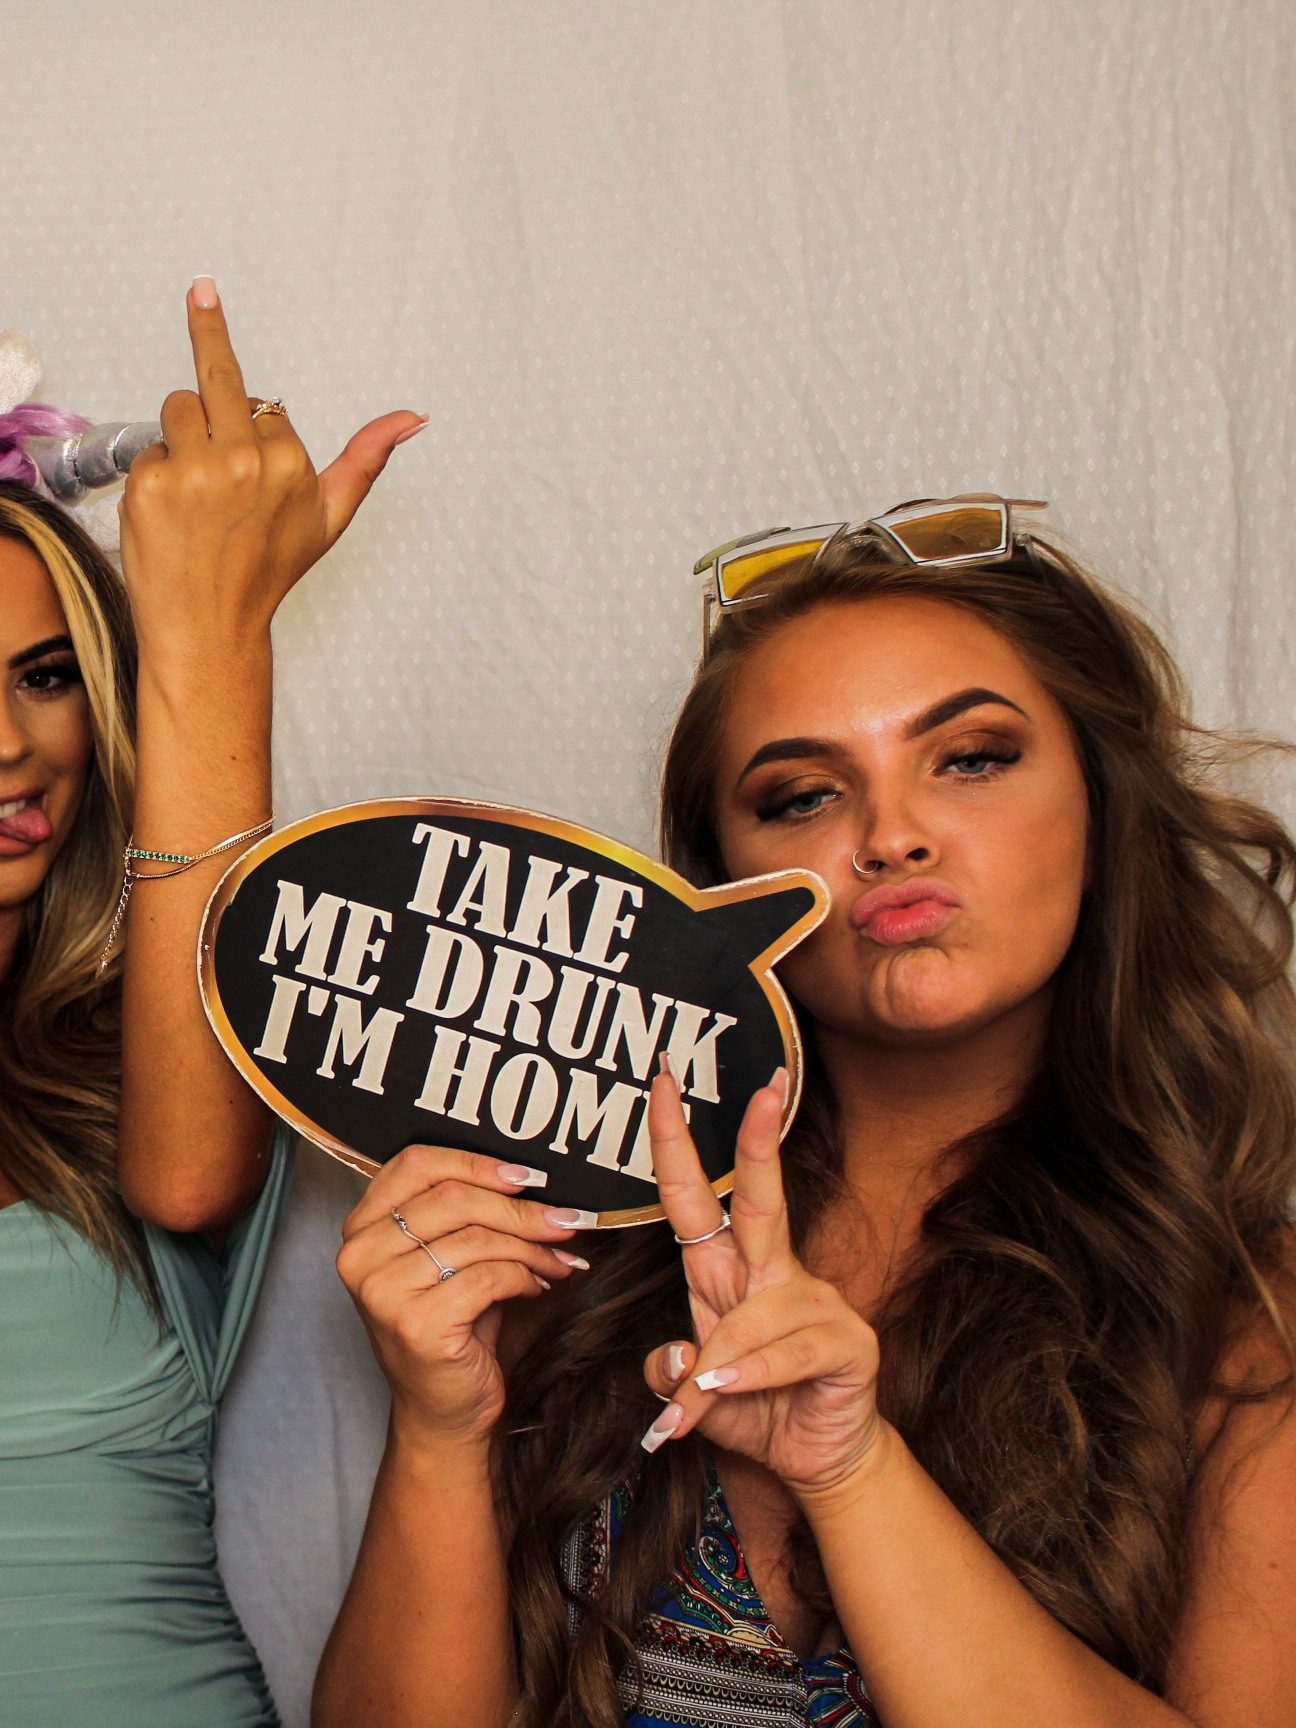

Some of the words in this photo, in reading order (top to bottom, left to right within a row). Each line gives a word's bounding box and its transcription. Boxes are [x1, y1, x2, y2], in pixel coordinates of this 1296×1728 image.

[406, 822, 643, 974] TAKE
[252, 974, 405, 1096] I'M
[258, 879, 393, 996] ME
[405, 924, 738, 1105] DRUNK
